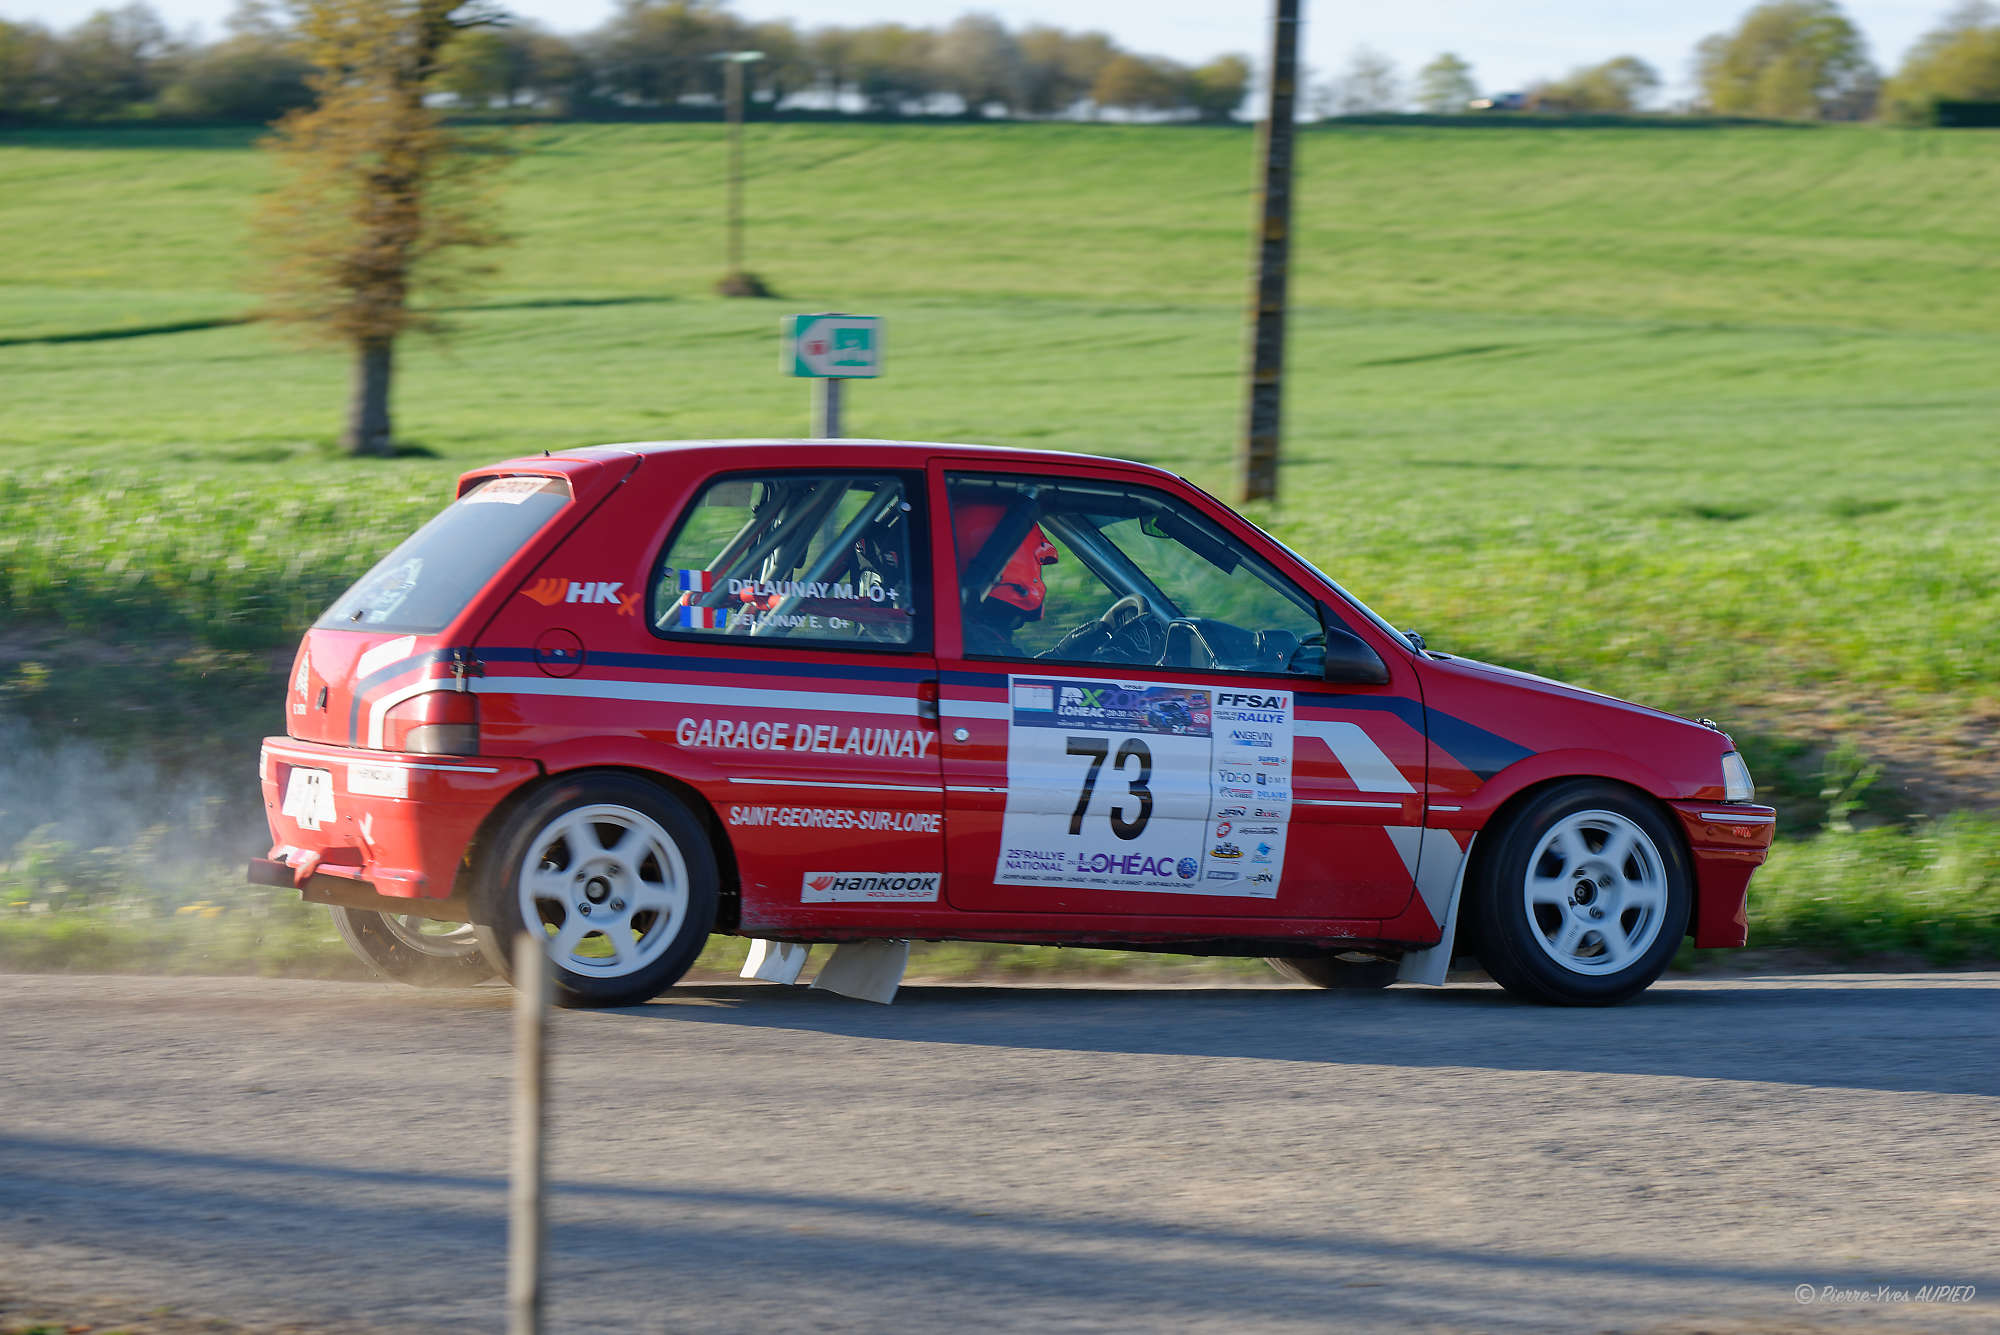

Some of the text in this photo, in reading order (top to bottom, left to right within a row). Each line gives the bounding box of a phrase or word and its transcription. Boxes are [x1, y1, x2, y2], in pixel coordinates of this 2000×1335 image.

[564, 581, 624, 604] HK
[727, 578, 829, 599] DELAUNAY
[833, 582, 860, 600] M.
[1217, 693, 1280, 709] FFSA
[1238, 712, 1285, 724] RALLYE
[676, 718, 935, 759] GARAGE DELAUNAY
[1066, 736, 1153, 841] 73
[728, 806, 942, 833] SAINT-GEORGES-SUR-LOIRE
[1007, 860, 1064, 871] NATIONAL
[1023, 850, 1065, 861] RALLYE
[1077, 852, 1175, 877] LOHÉAC
